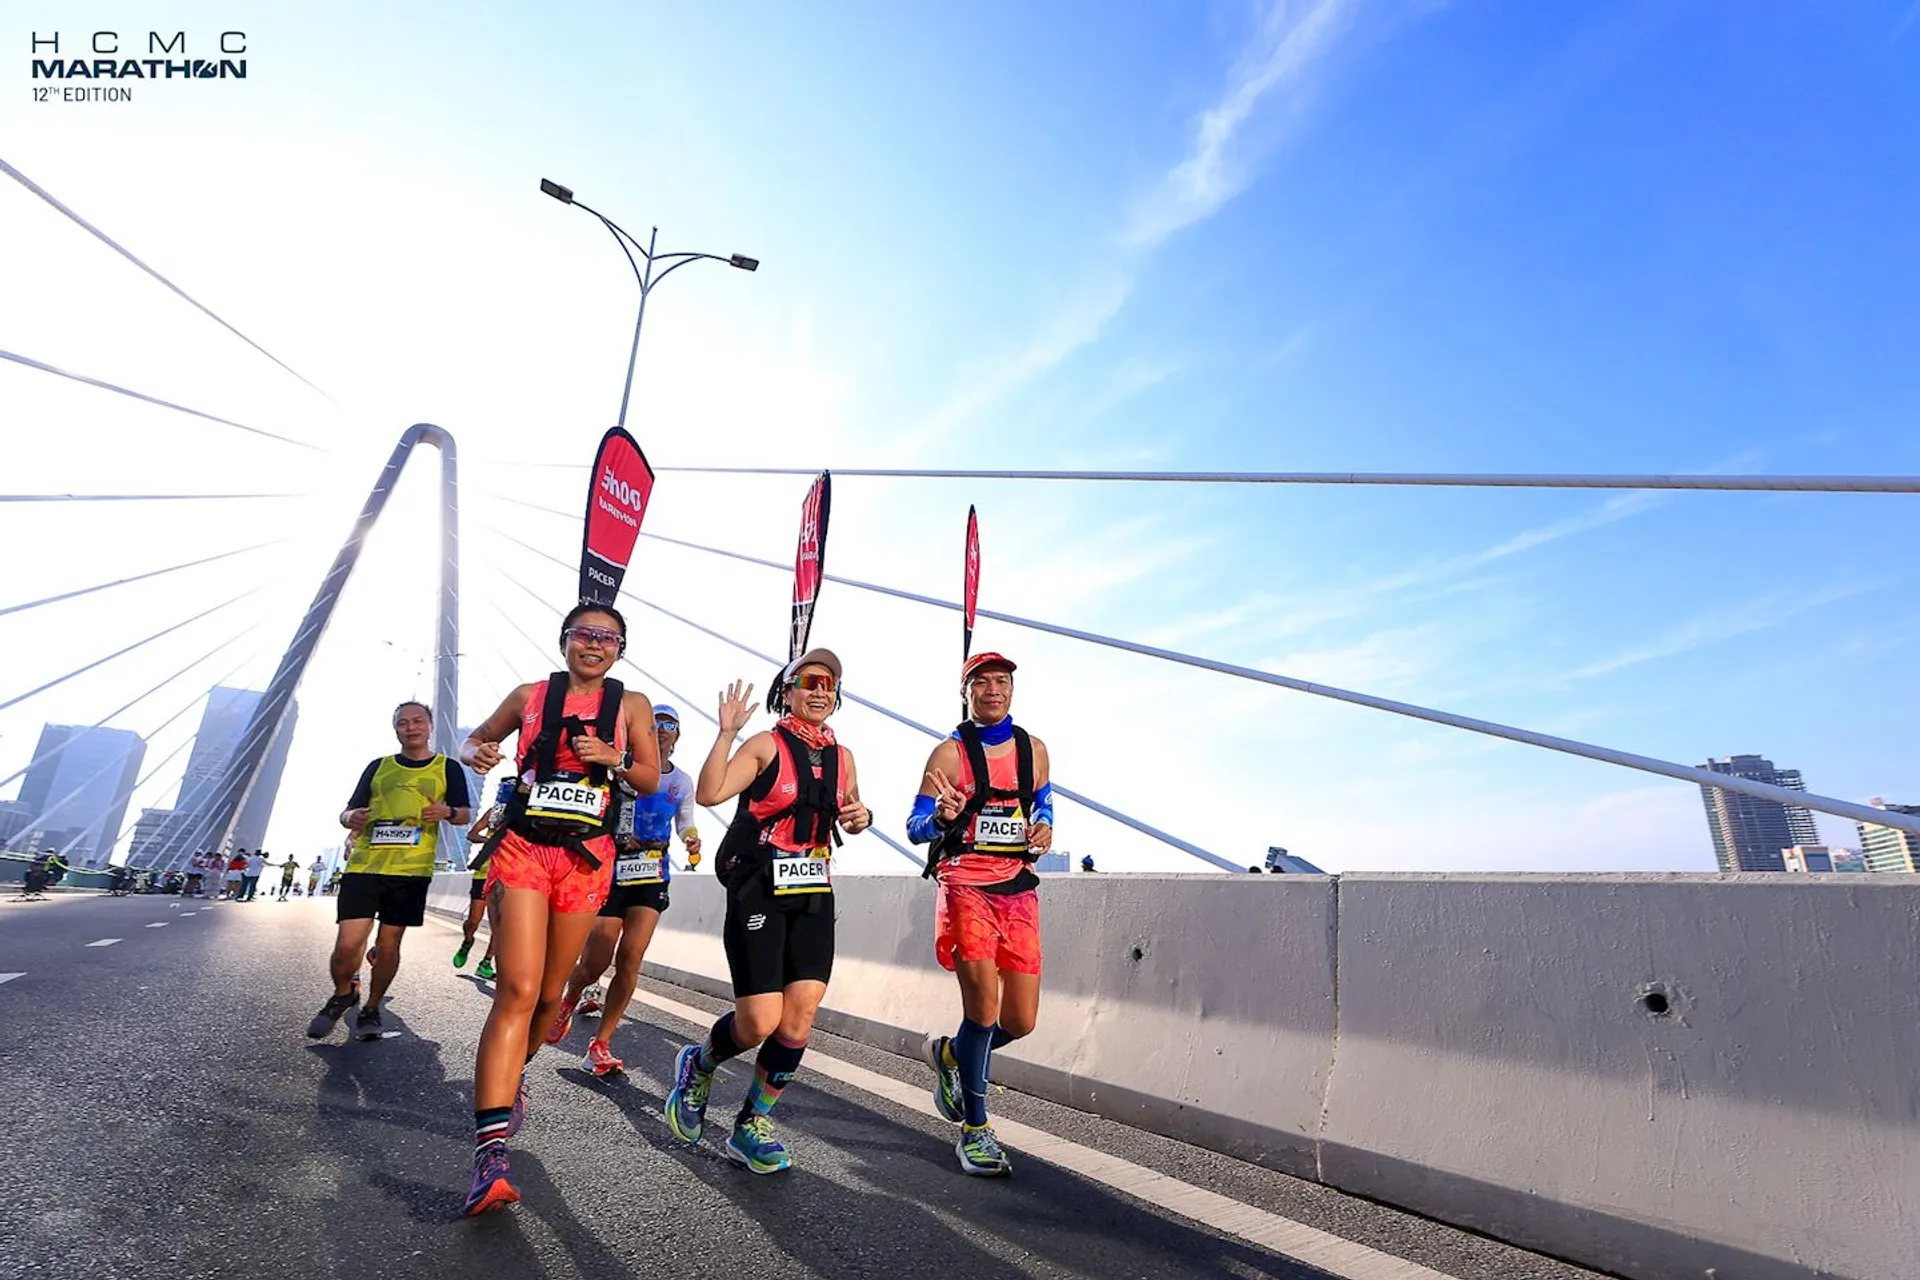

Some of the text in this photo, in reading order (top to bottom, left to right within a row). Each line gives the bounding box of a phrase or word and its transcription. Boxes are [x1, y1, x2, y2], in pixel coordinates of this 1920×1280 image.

[587, 566, 616, 588] PACER
[536, 785, 597, 806] PACER
[980, 821, 1024, 836] PACER
[778, 862, 824, 878] PACER
